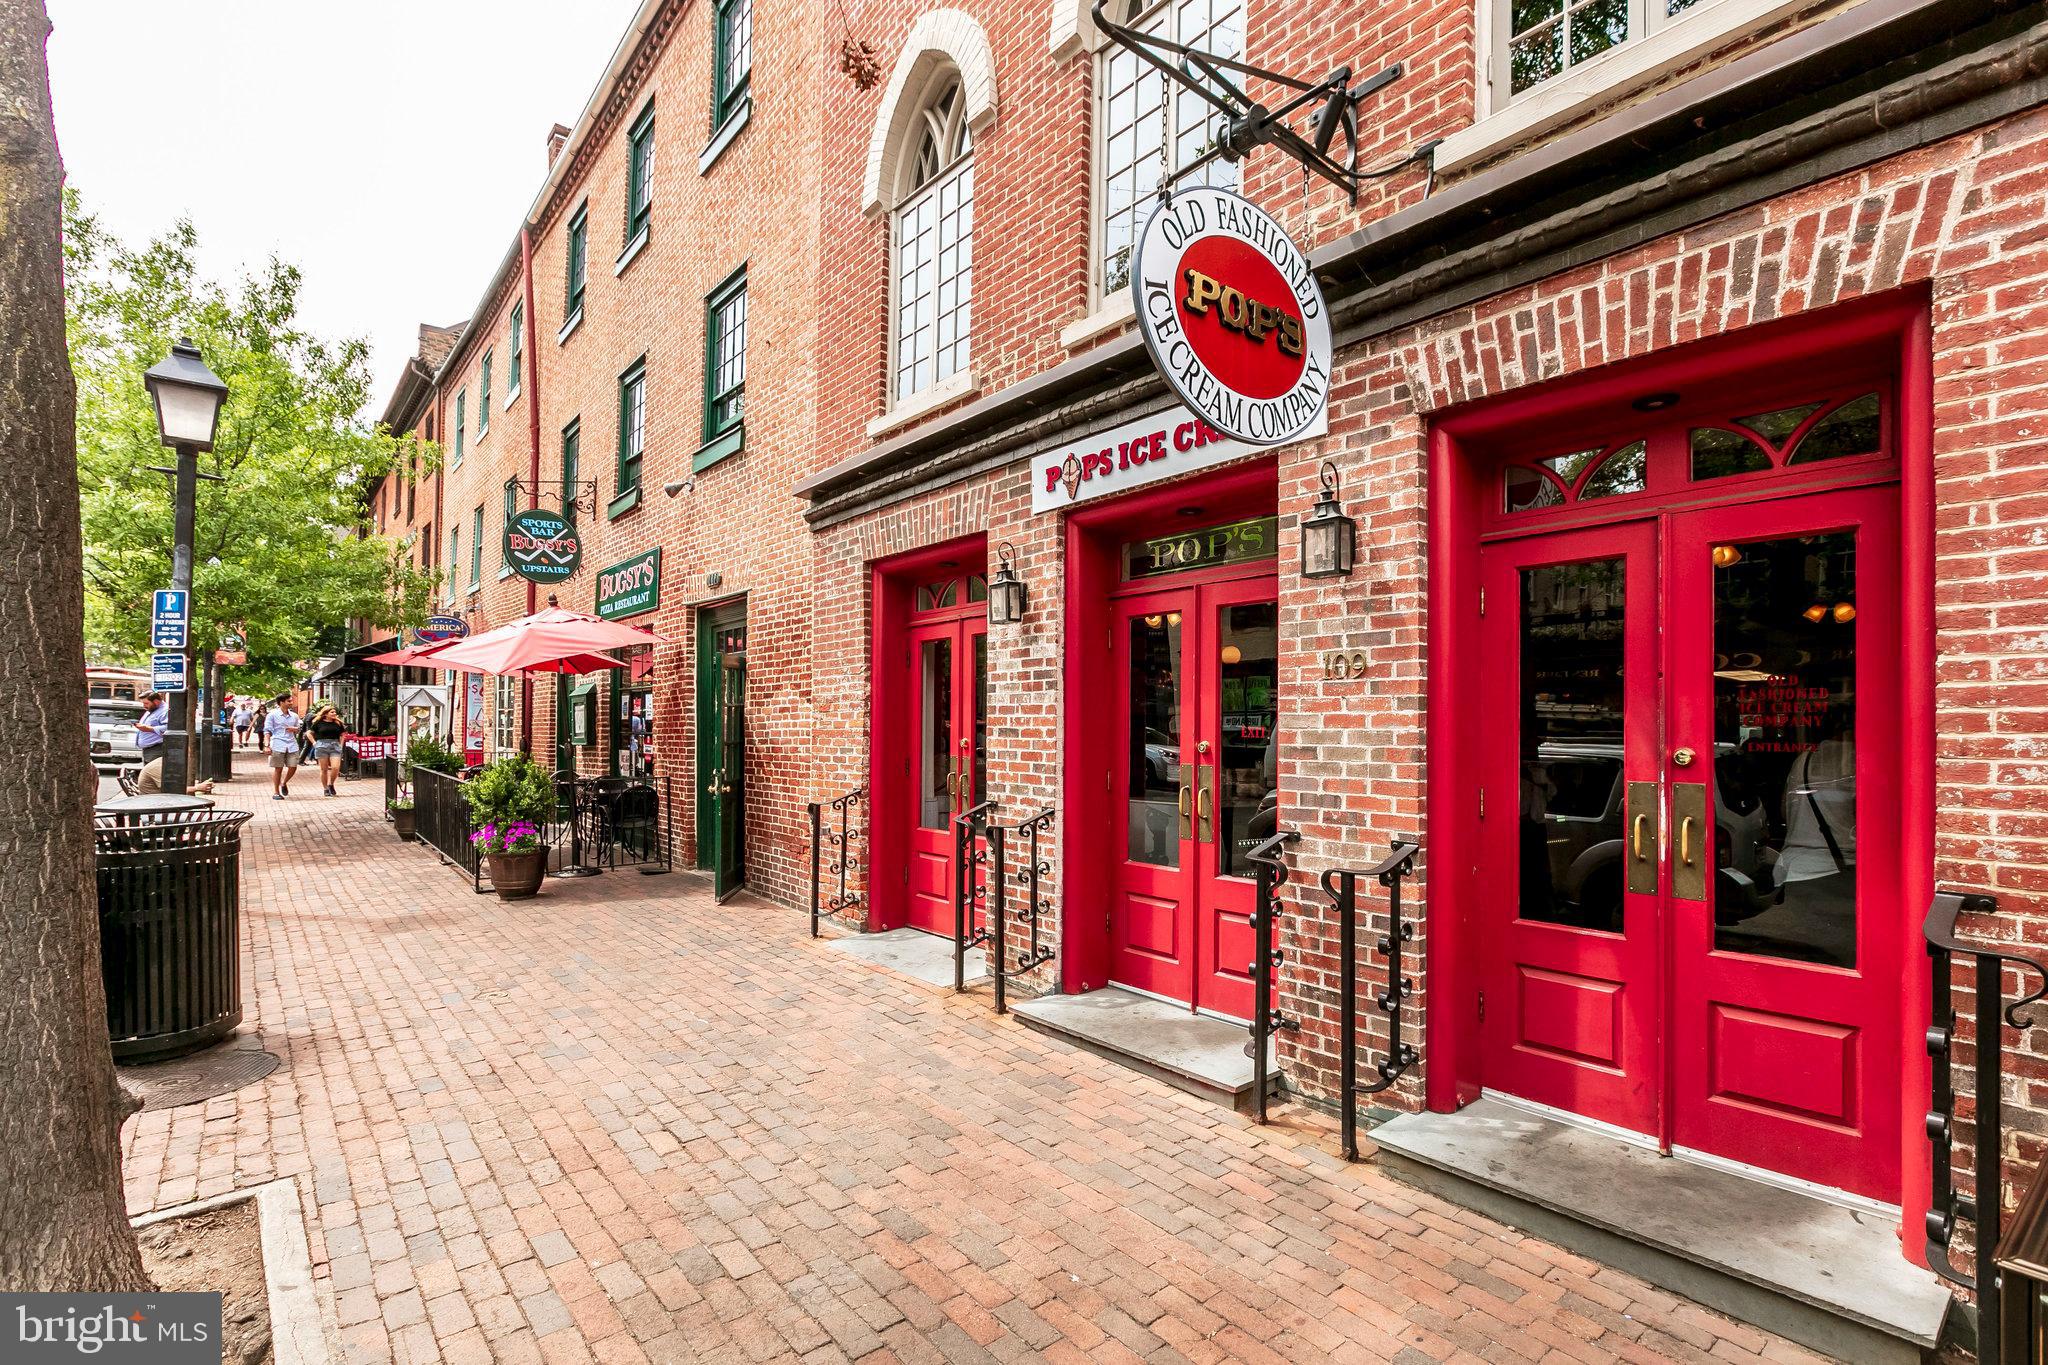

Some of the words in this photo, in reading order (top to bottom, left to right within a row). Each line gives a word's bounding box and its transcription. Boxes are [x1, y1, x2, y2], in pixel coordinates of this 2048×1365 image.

[1162, 199, 1206, 250] OLD
[1215, 197, 1319, 320] FASHIONED
[1186, 268, 1305, 354] POP'S
[1144, 276, 1179, 343] ICE
[1169, 341, 1244, 434] CREAM
[1248, 350, 1328, 438] COMPANY
[1118, 430, 1167, 471] ICE
[521, 518, 563, 529] SPORTS
[531, 527, 555, 536] BAR
[509, 533, 577, 554] BUGSY'S
[1150, 525, 1264, 569] POP'S
[521, 564, 570, 574] UPSTAIRS
[599, 556, 654, 601] BUGSY'S
[165, 593, 176, 610] P
[600, 603, 613, 615] PIZZA
[614, 591, 650, 611] RESTAURANT
[1322, 652, 1367, 680] 109
[1768, 675, 1799, 687] OLD
[1739, 687, 1829, 701] FASHIONED
[1740, 701, 1765, 714] ICE
[1770, 701, 1829, 713] CREAM
[1743, 715, 1823, 728] COMPANY
[1241, 726, 1265, 738] EXIT
[1748, 743, 1818, 753] ENTRANCE
